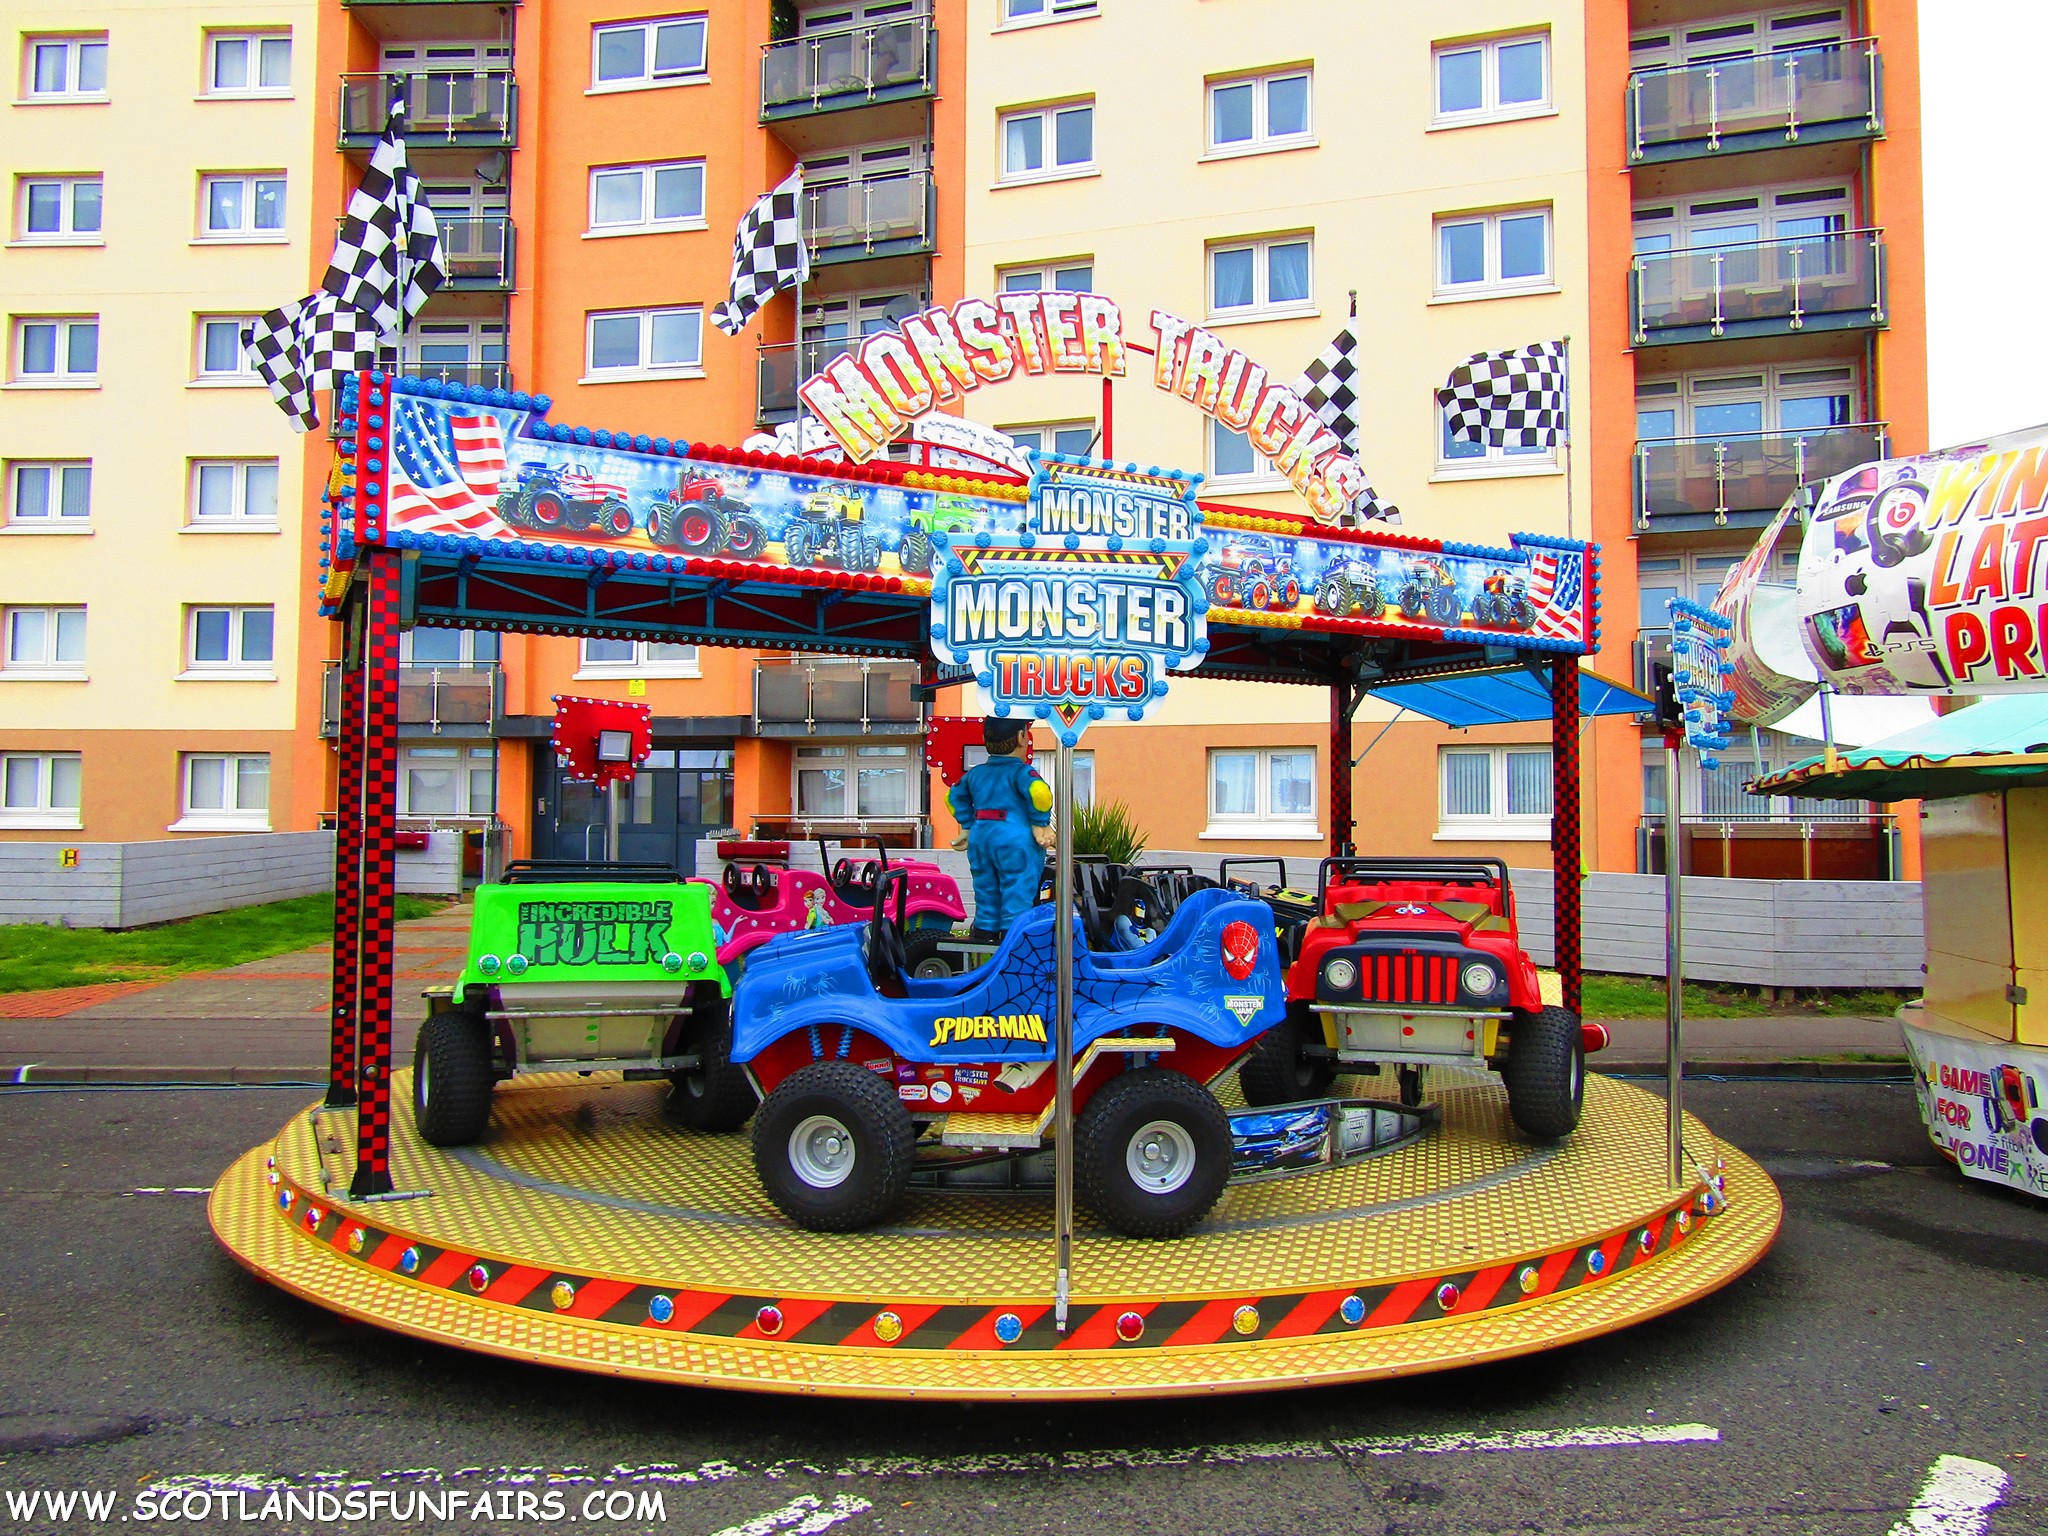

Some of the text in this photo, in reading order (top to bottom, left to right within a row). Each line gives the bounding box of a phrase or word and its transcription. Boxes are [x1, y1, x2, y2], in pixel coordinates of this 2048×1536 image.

[799, 292, 1361, 521] MONSTER TRUCKS
[1041, 487, 1191, 539] MONSTER
[1822, 500, 1868, 516] SAMSUNG
[1928, 517, 2048, 608] LAT
[953, 580, 1186, 648] MONSTER
[1886, 638, 1937, 653] PS5
[996, 652, 1145, 699] TRUCKS
[530, 903, 671, 922] INCREDIBLE
[519, 921, 671, 965] HULK
[1227, 998, 1262, 1008] MONSTER
[929, 1013, 1048, 1047] SPIDER-MAN
[1940, 1064, 1991, 1097] GAME
[1937, 1097, 1971, 1131] FOR
